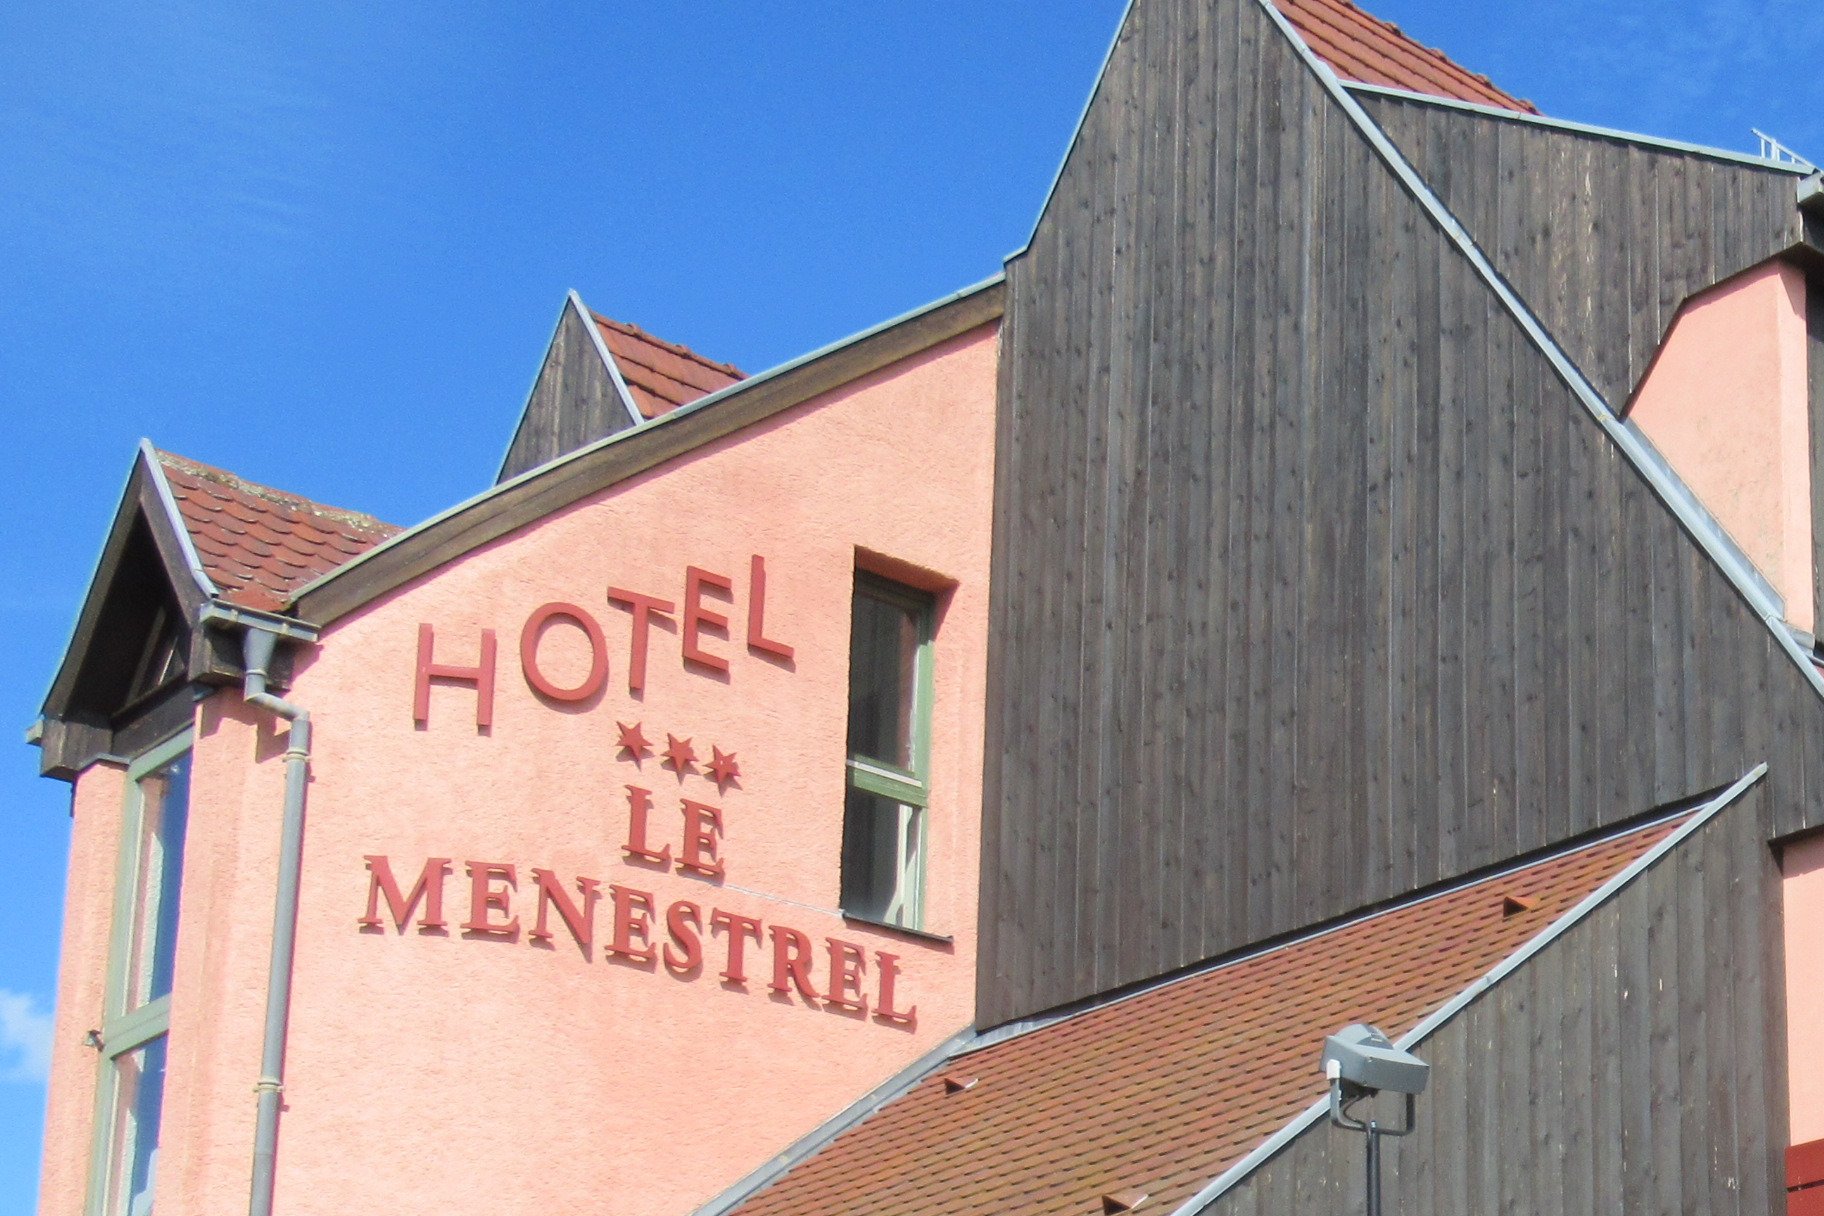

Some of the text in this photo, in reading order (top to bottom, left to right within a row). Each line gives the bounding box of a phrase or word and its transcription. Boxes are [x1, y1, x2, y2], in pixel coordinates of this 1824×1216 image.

[413, 553, 795, 728] HOTEL
[621, 784, 726, 876] LE
[357, 854, 917, 1025] MENESTREL
